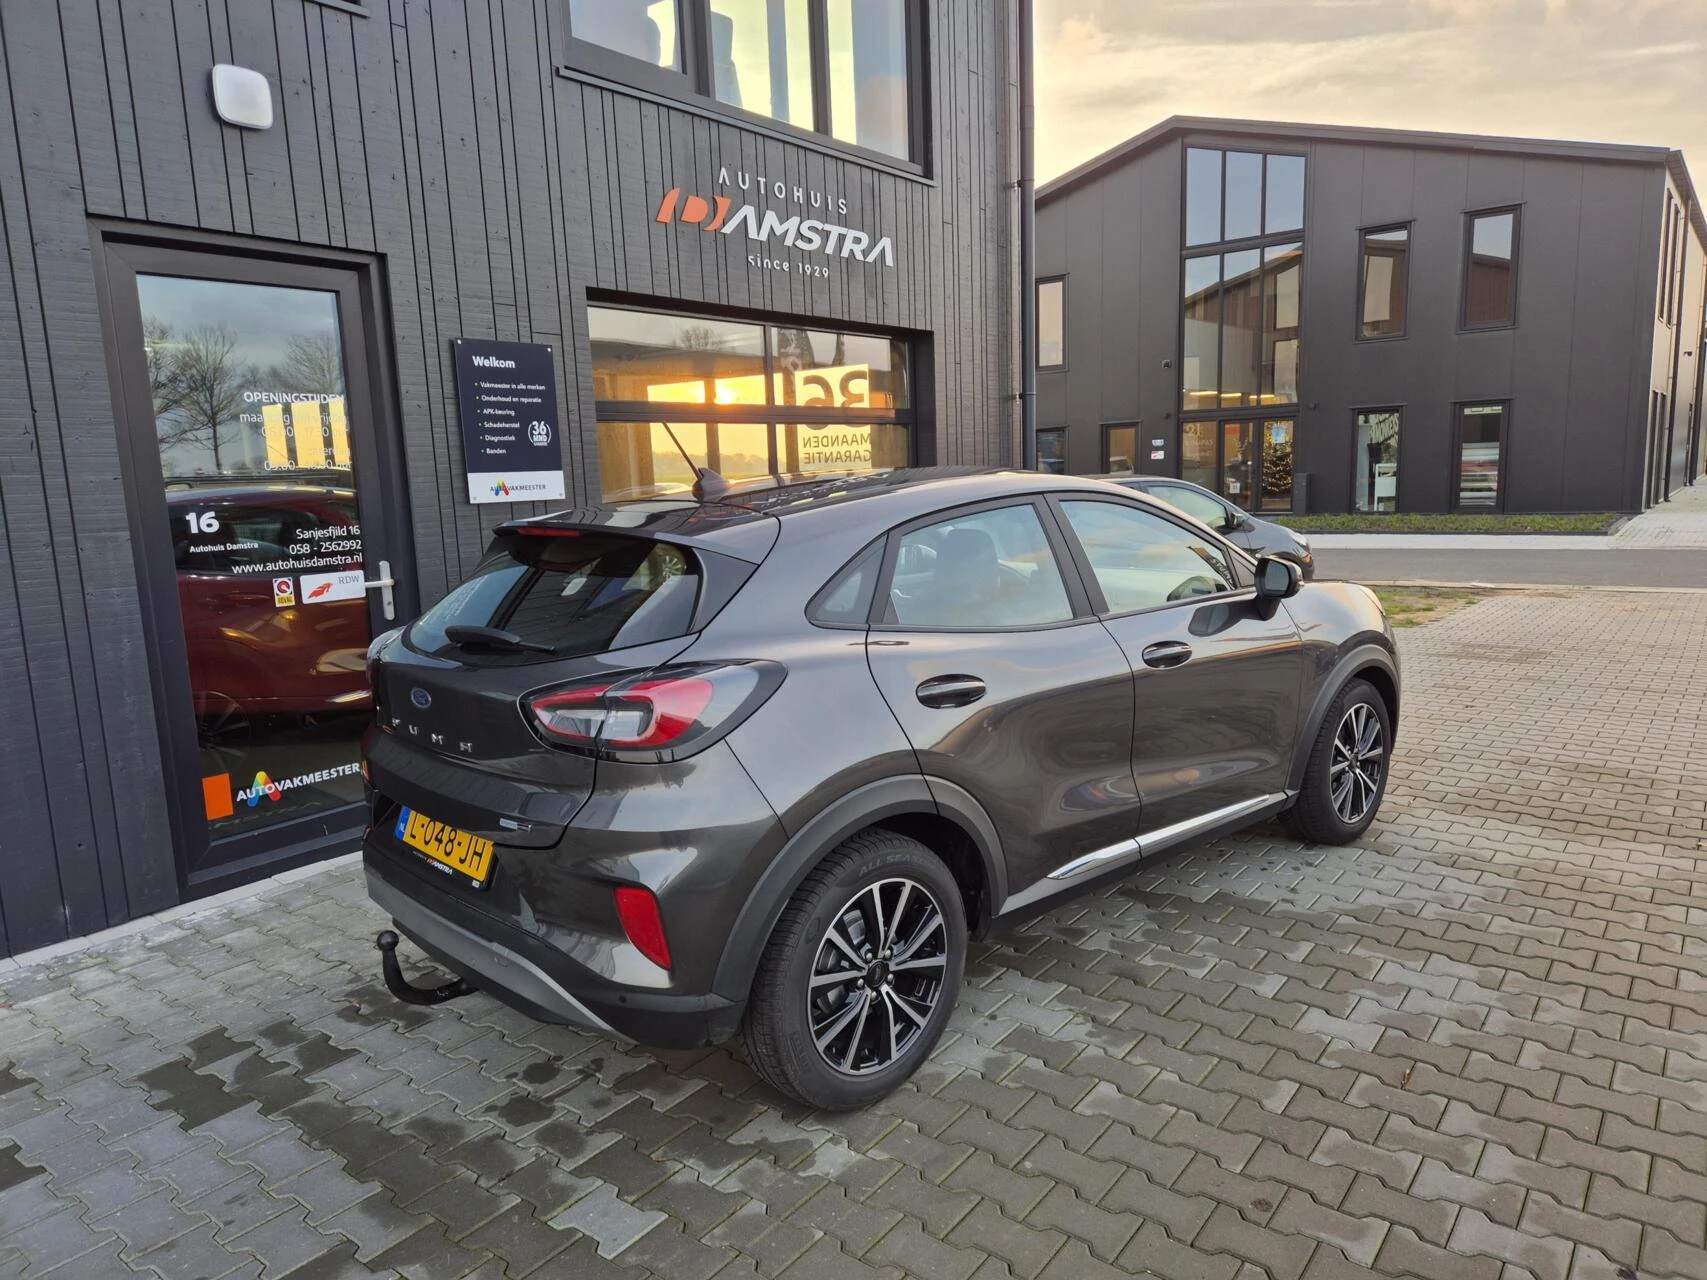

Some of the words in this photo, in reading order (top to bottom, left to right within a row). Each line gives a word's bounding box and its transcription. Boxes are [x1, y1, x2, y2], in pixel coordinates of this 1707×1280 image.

[718, 167, 847, 215] AUTOHUIS
[656, 187, 894, 267] DAMSTRA
[748, 253, 790, 272] since
[798, 262, 829, 279] 1929
[472, 355, 516, 369] Welkom
[480, 381, 511, 389] Vakmeester
[517, 382, 527, 390] alle
[526, 383, 546, 391] merken
[243, 391, 345, 404] OPENINGSTIJDEN
[484, 421, 520, 429] Schadeherstel
[531, 420, 547, 435] 36
[484, 435, 516, 443] Diagnostiek
[533, 434, 548, 442] MND
[490, 484, 547, 492] AUVAKMEESTER
[185, 511, 220, 534] 16
[296, 525, 347, 540] Sanjesfjild
[348, 525, 361, 535] 16
[189, 543, 226, 553] Autohuis
[226, 542, 259, 551] Damstra
[289, 544, 311, 555] 058
[320, 540, 363, 552] 2562992
[232, 552, 363, 574] www.autohuisdamstra.nl
[337, 575, 360, 585] RDW
[236, 762, 361, 802] AUTOVAKMEESTER
[410, 812, 487, 872] L-048-JH
